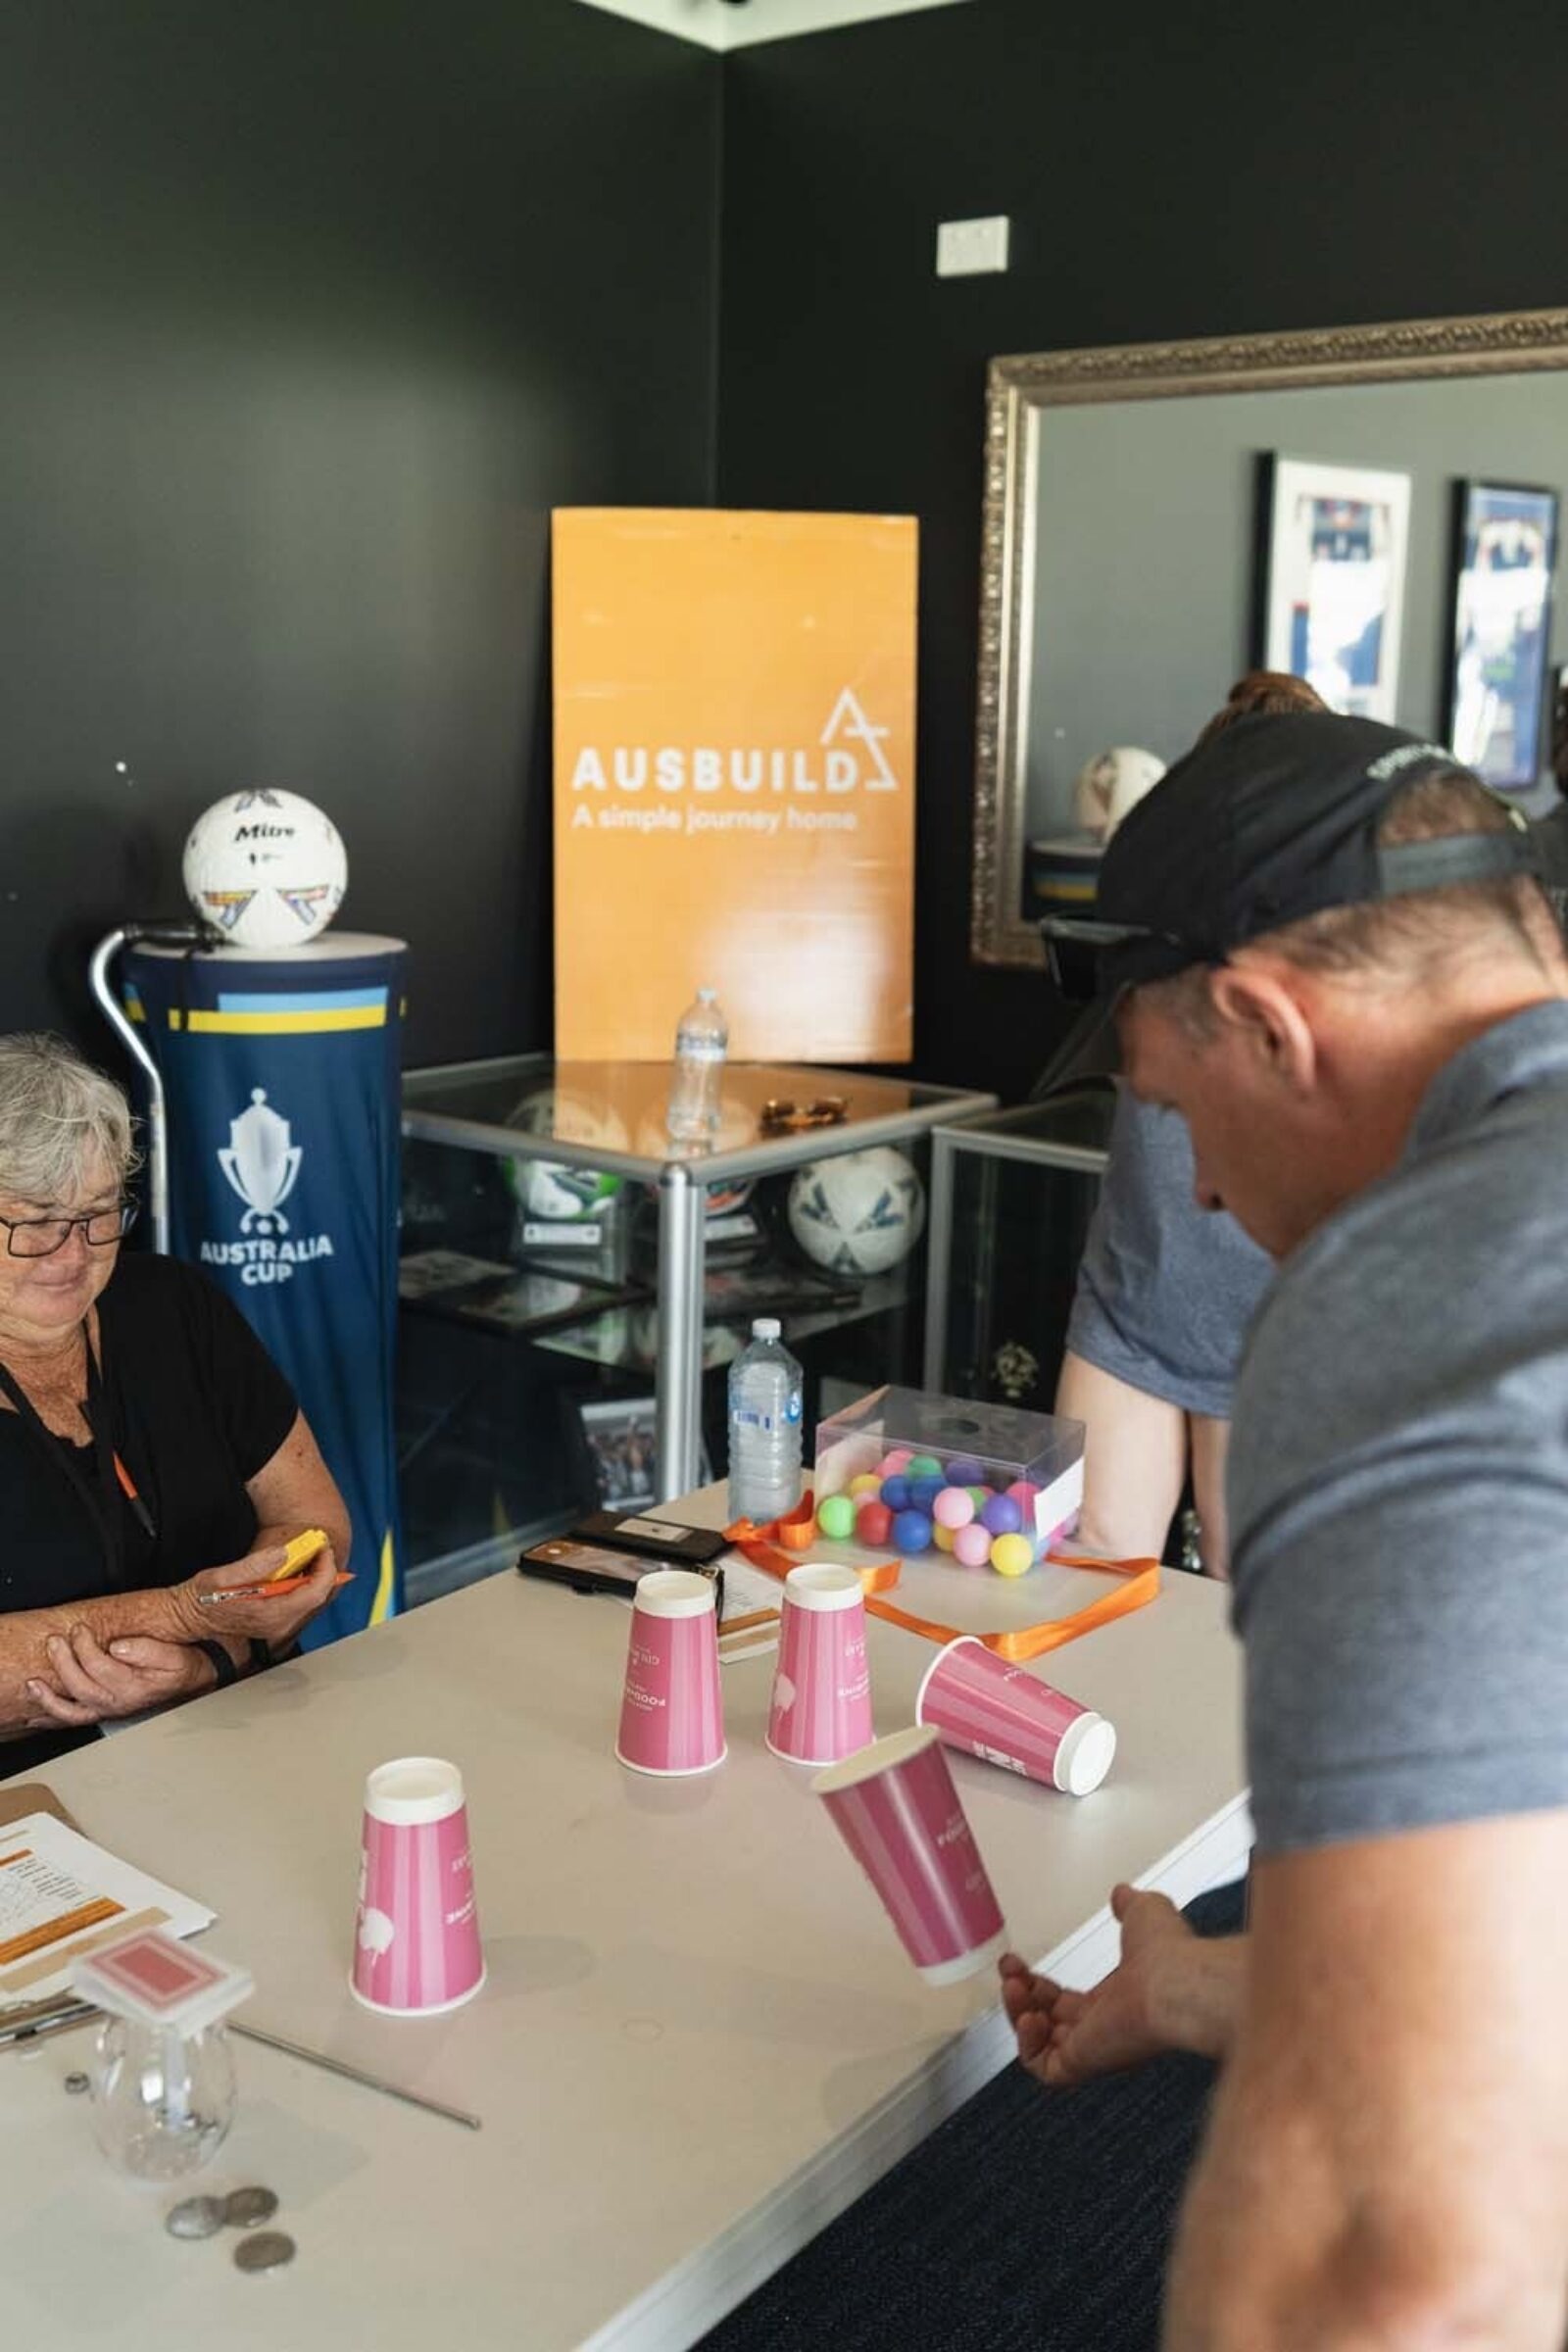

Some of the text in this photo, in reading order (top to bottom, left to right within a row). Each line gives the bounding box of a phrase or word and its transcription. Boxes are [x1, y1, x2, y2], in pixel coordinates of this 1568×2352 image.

[571, 747, 858, 792] AUSBUILD
[233, 823, 295, 842] Mitre
[571, 803, 858, 836] A simple journey home
[200, 1234, 334, 1265] AUSTRALIA
[241, 1261, 293, 1286] CUP
